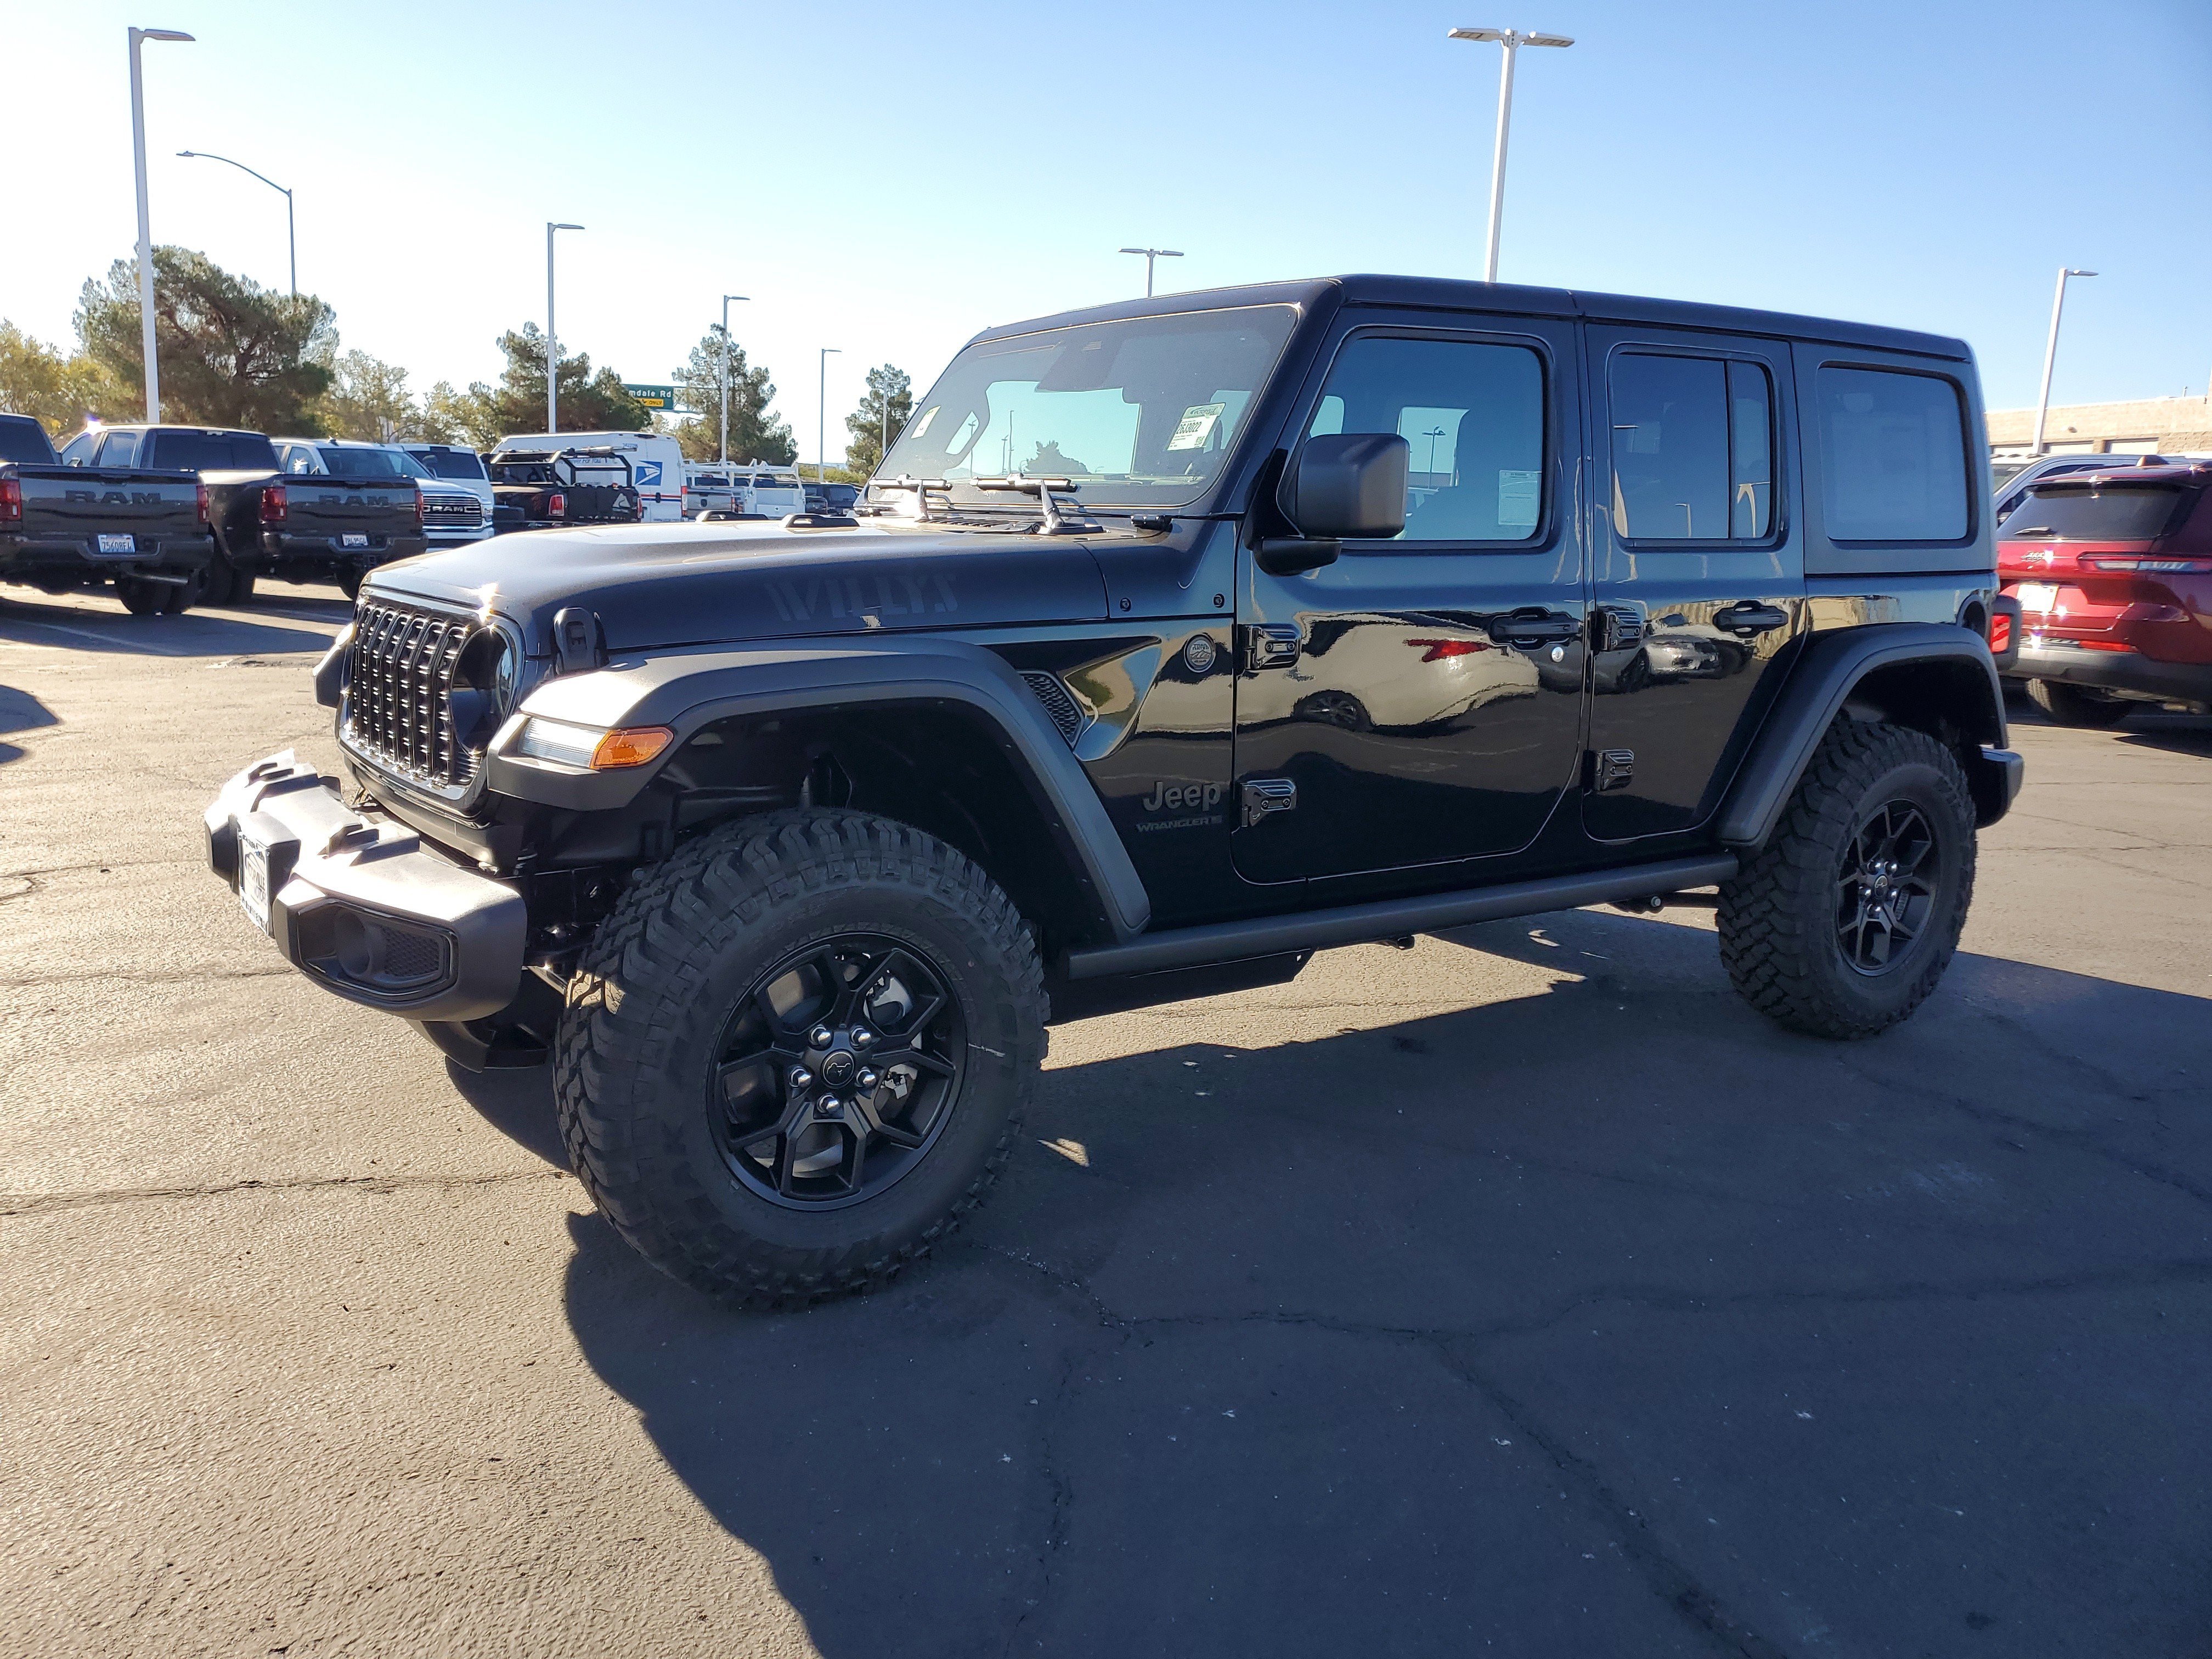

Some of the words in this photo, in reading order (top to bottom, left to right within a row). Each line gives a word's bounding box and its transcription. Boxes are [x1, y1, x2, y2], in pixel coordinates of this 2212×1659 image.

[1176, 421, 1202, 434] 26J3022
[65, 490, 161, 504] RAM
[318, 495, 389, 506] RAM
[761, 573, 959, 622] WILLYS
[1143, 781, 1221, 811] Jeep
[1136, 818, 1210, 833] WRANGLER
